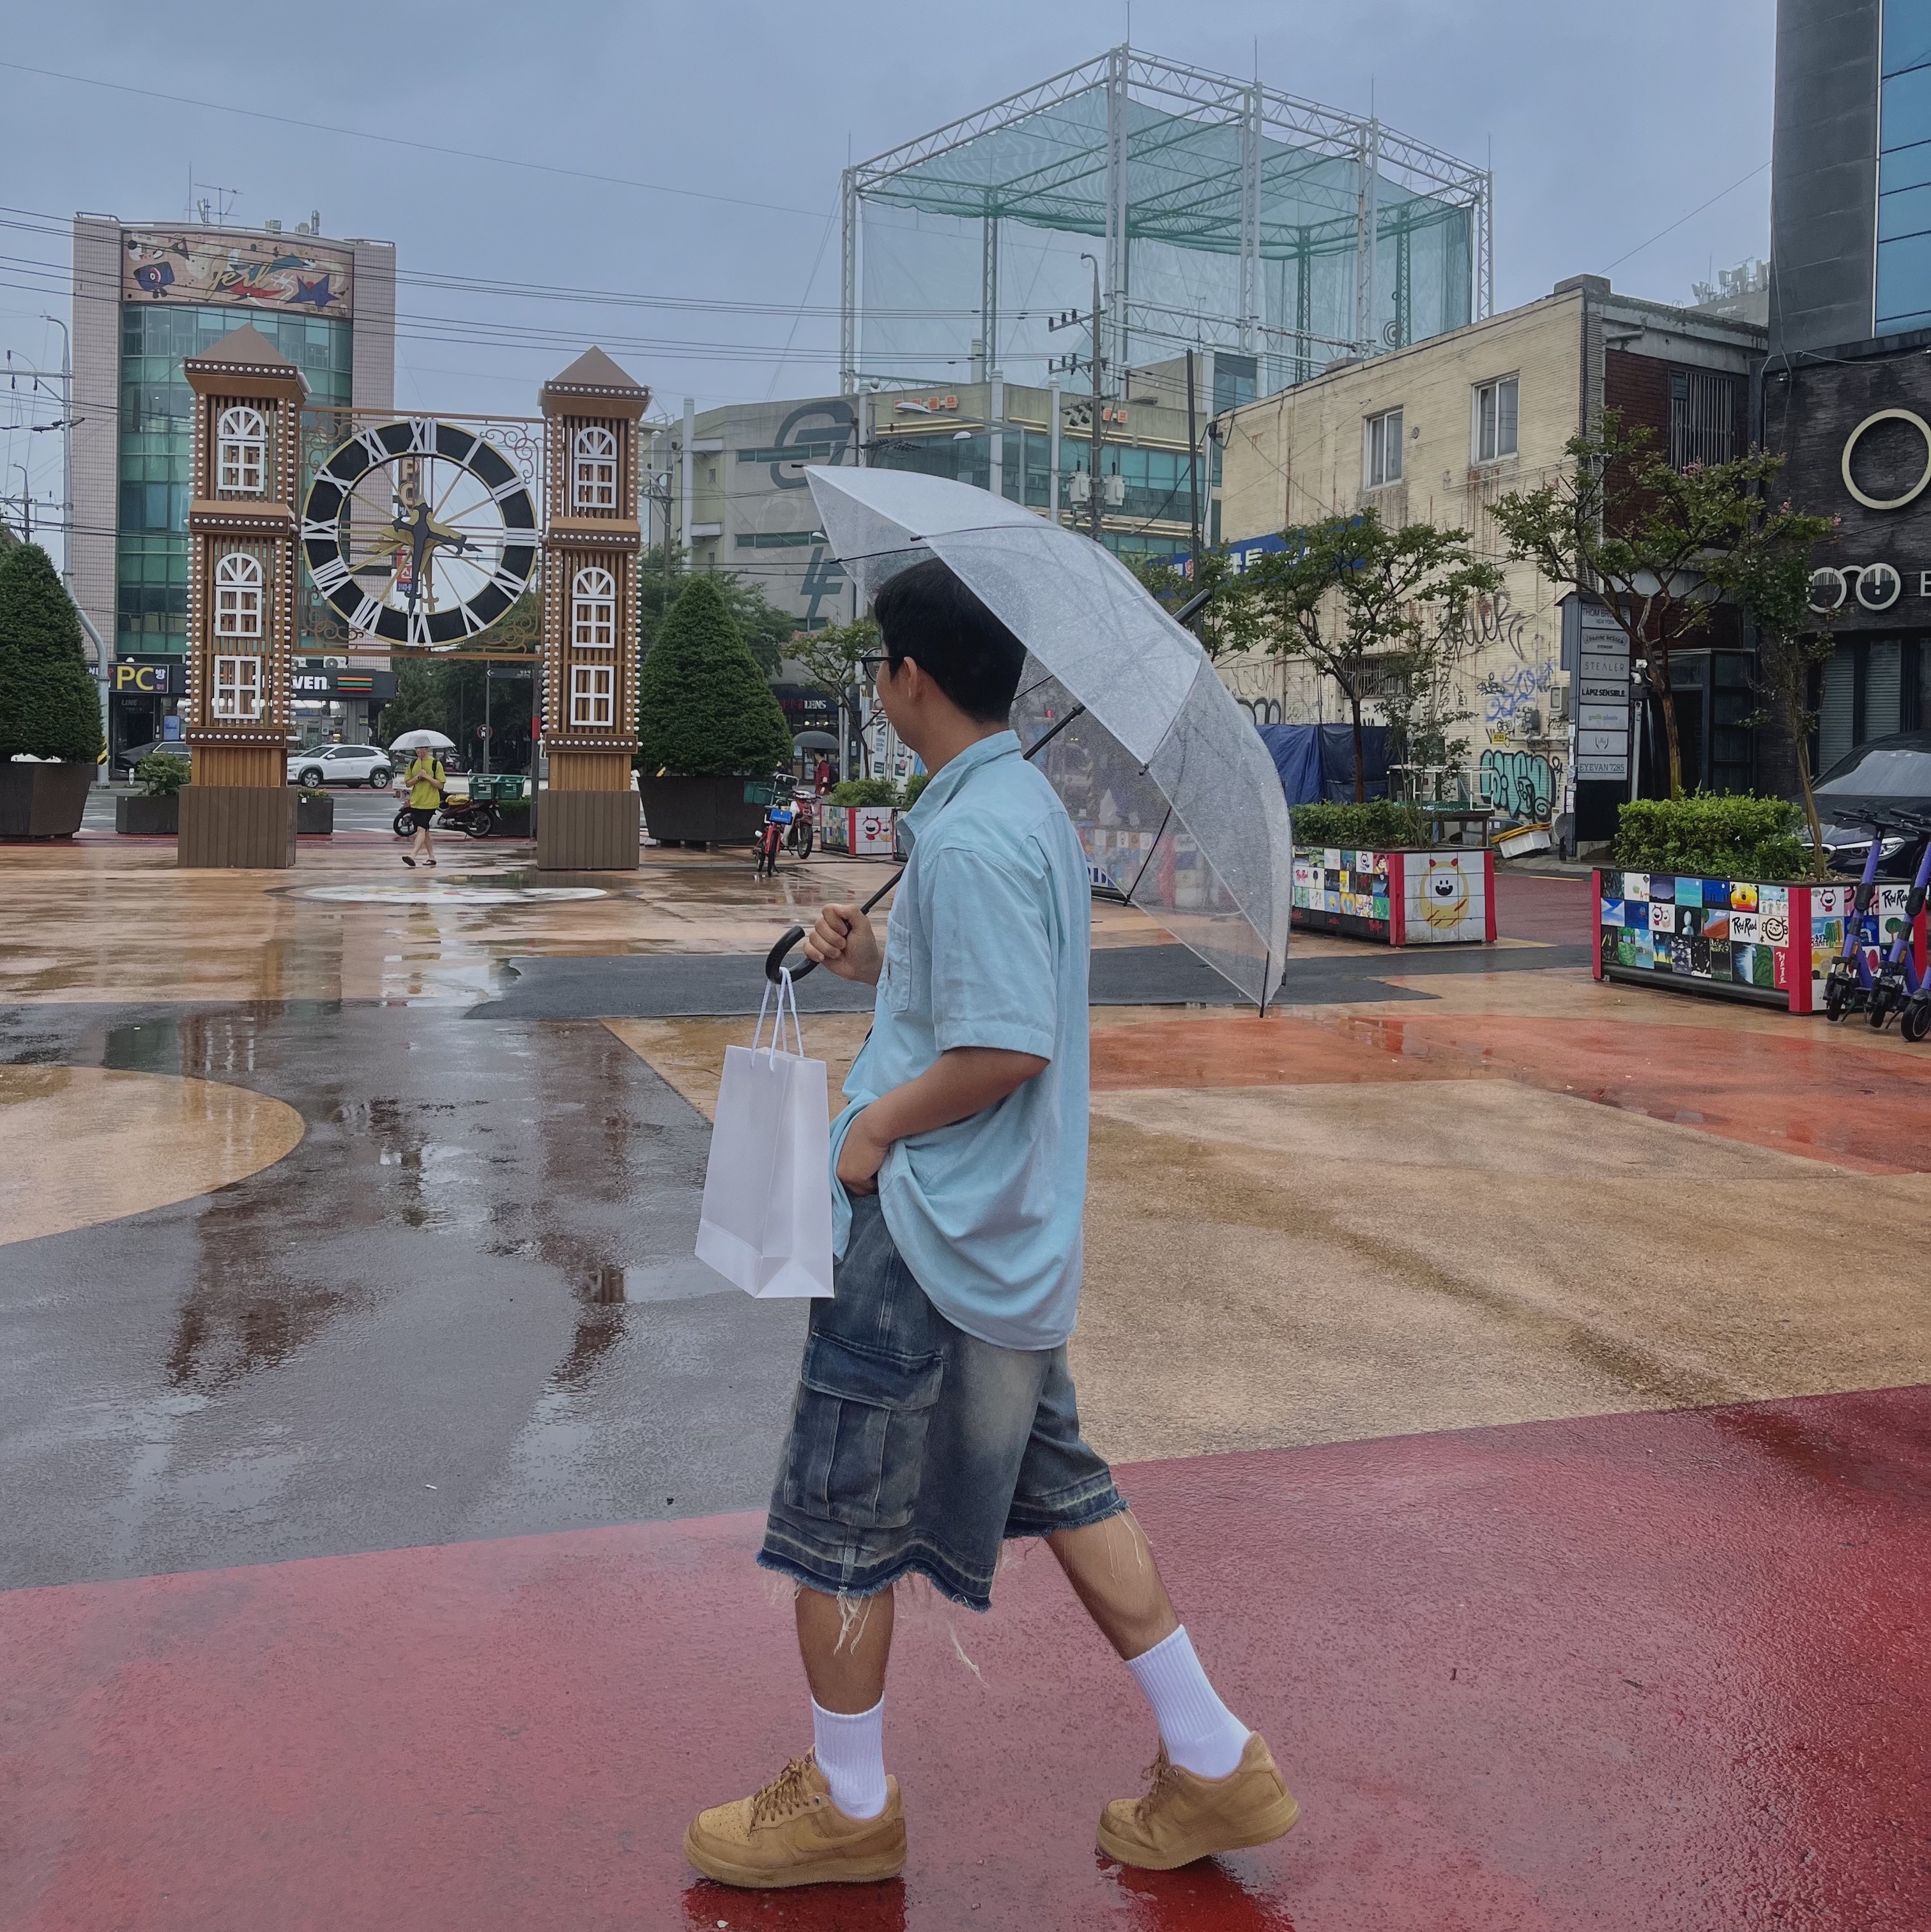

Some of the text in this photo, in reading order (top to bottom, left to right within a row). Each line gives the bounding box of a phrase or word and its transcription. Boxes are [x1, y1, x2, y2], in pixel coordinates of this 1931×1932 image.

[1582, 607, 1599, 617] THOM
[1584, 662, 1624, 672] STEALER
[804, 700, 827, 710] LENS
[1579, 763, 1625, 772] EYEVAN 7285
